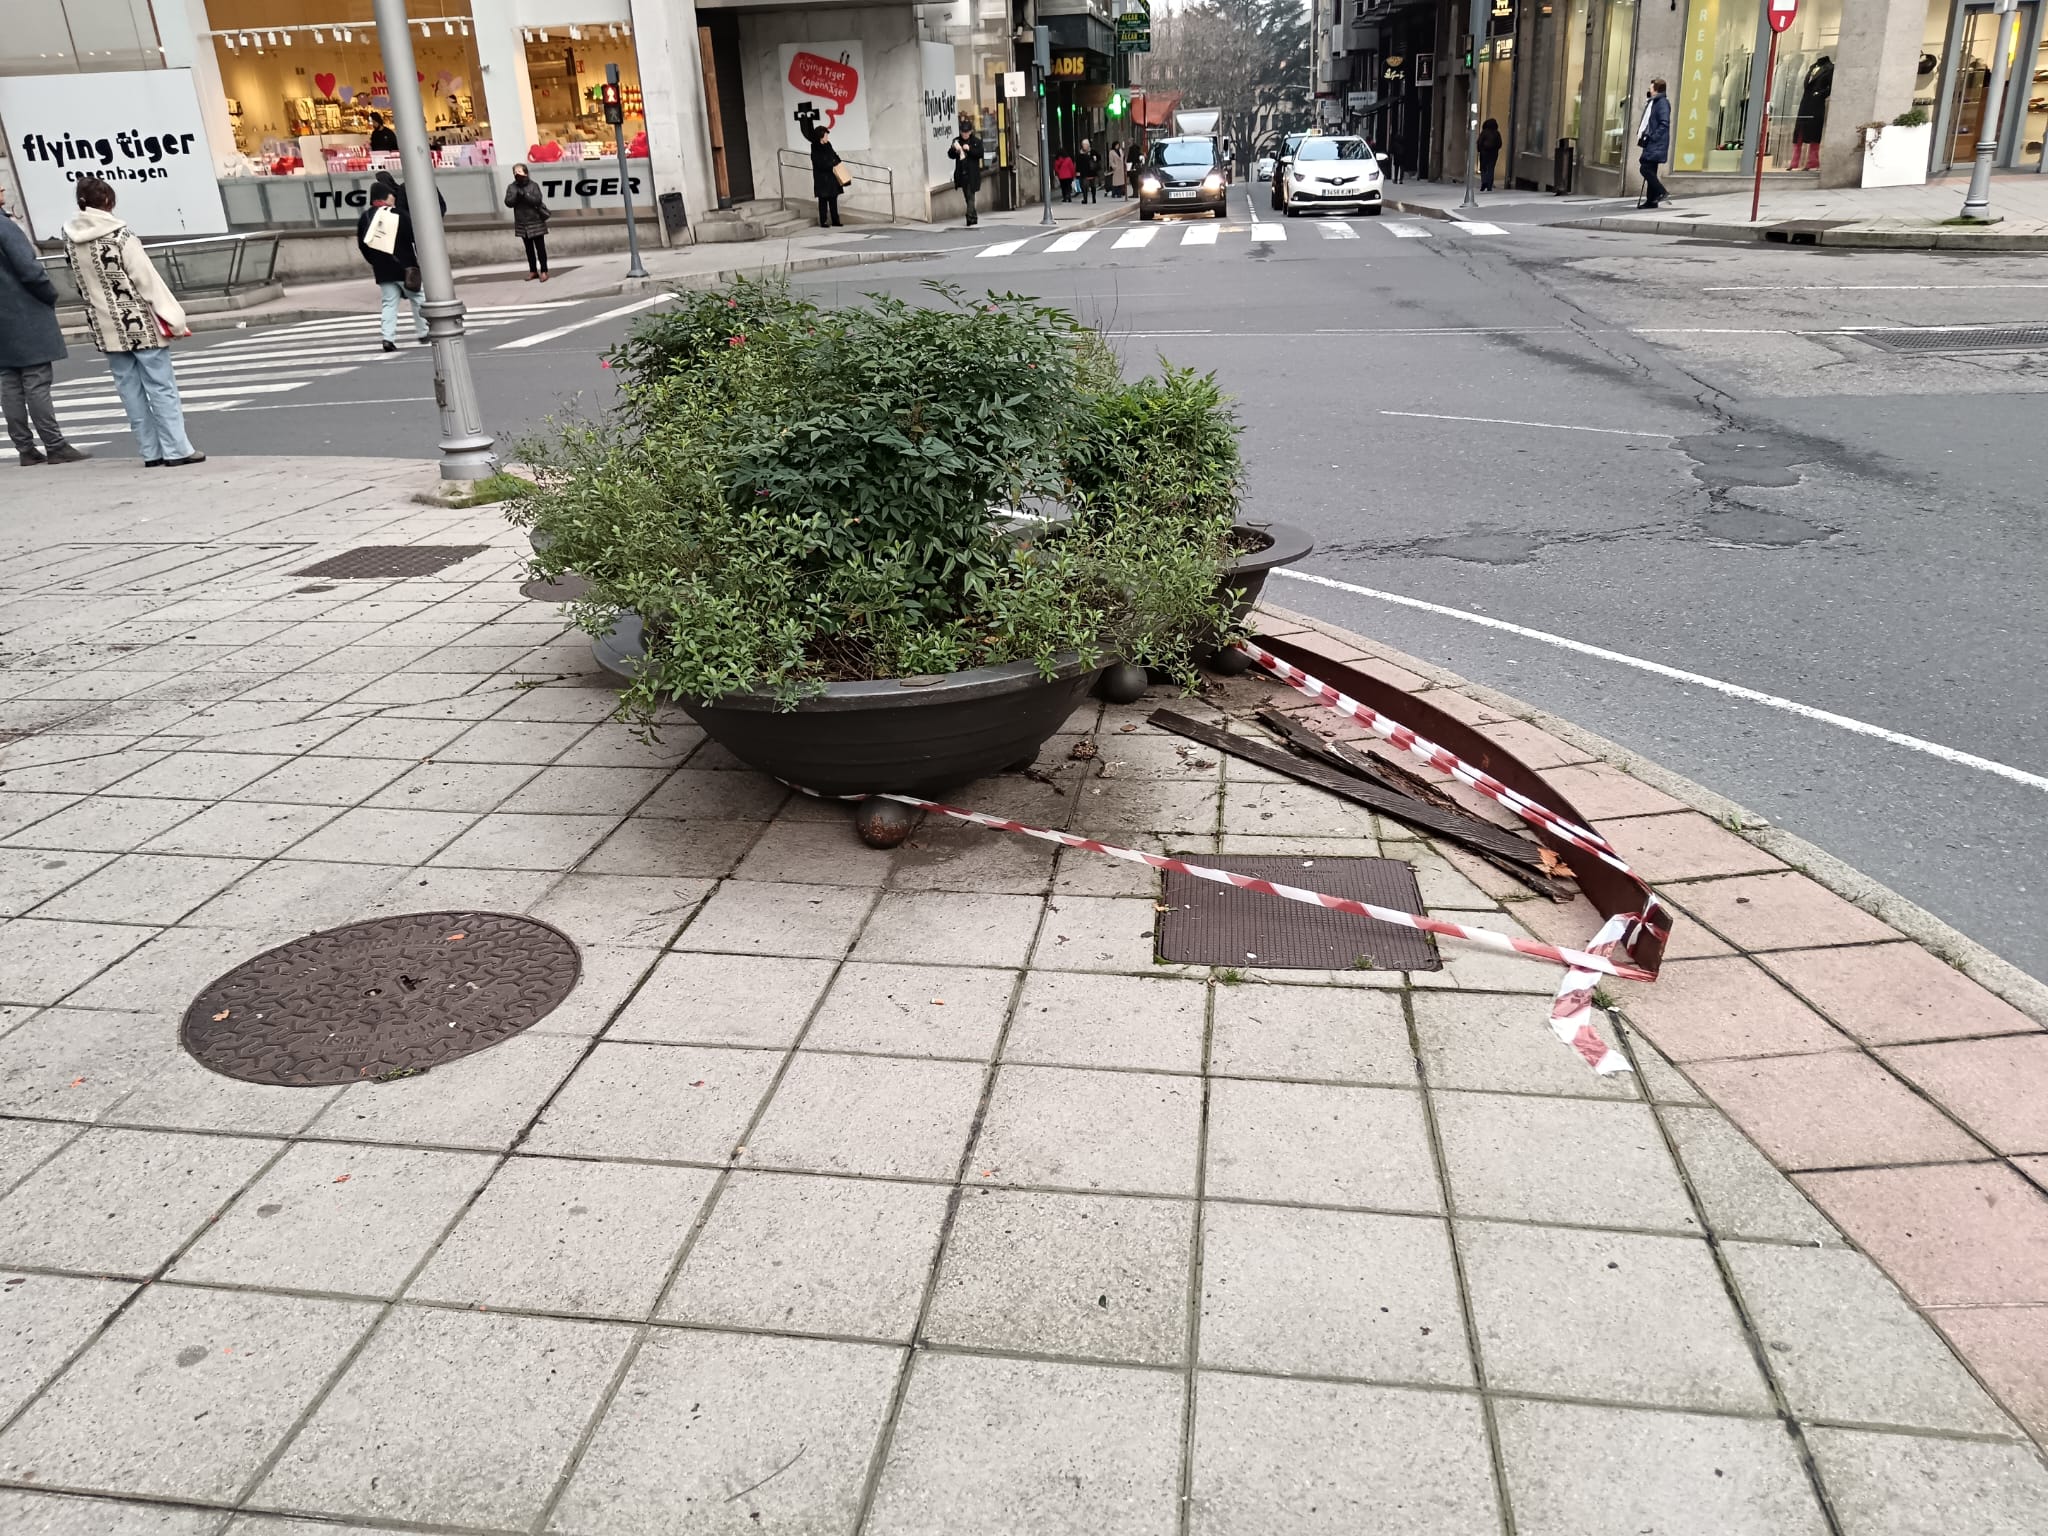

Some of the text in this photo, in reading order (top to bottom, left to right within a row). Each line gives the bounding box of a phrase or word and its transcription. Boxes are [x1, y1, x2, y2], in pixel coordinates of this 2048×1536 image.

[1687, 8, 1708, 140] REBAJAS
[22, 128, 195, 168] flying tiger
[313, 190, 368, 209] TIG
[542, 177, 641, 198] TIGER
